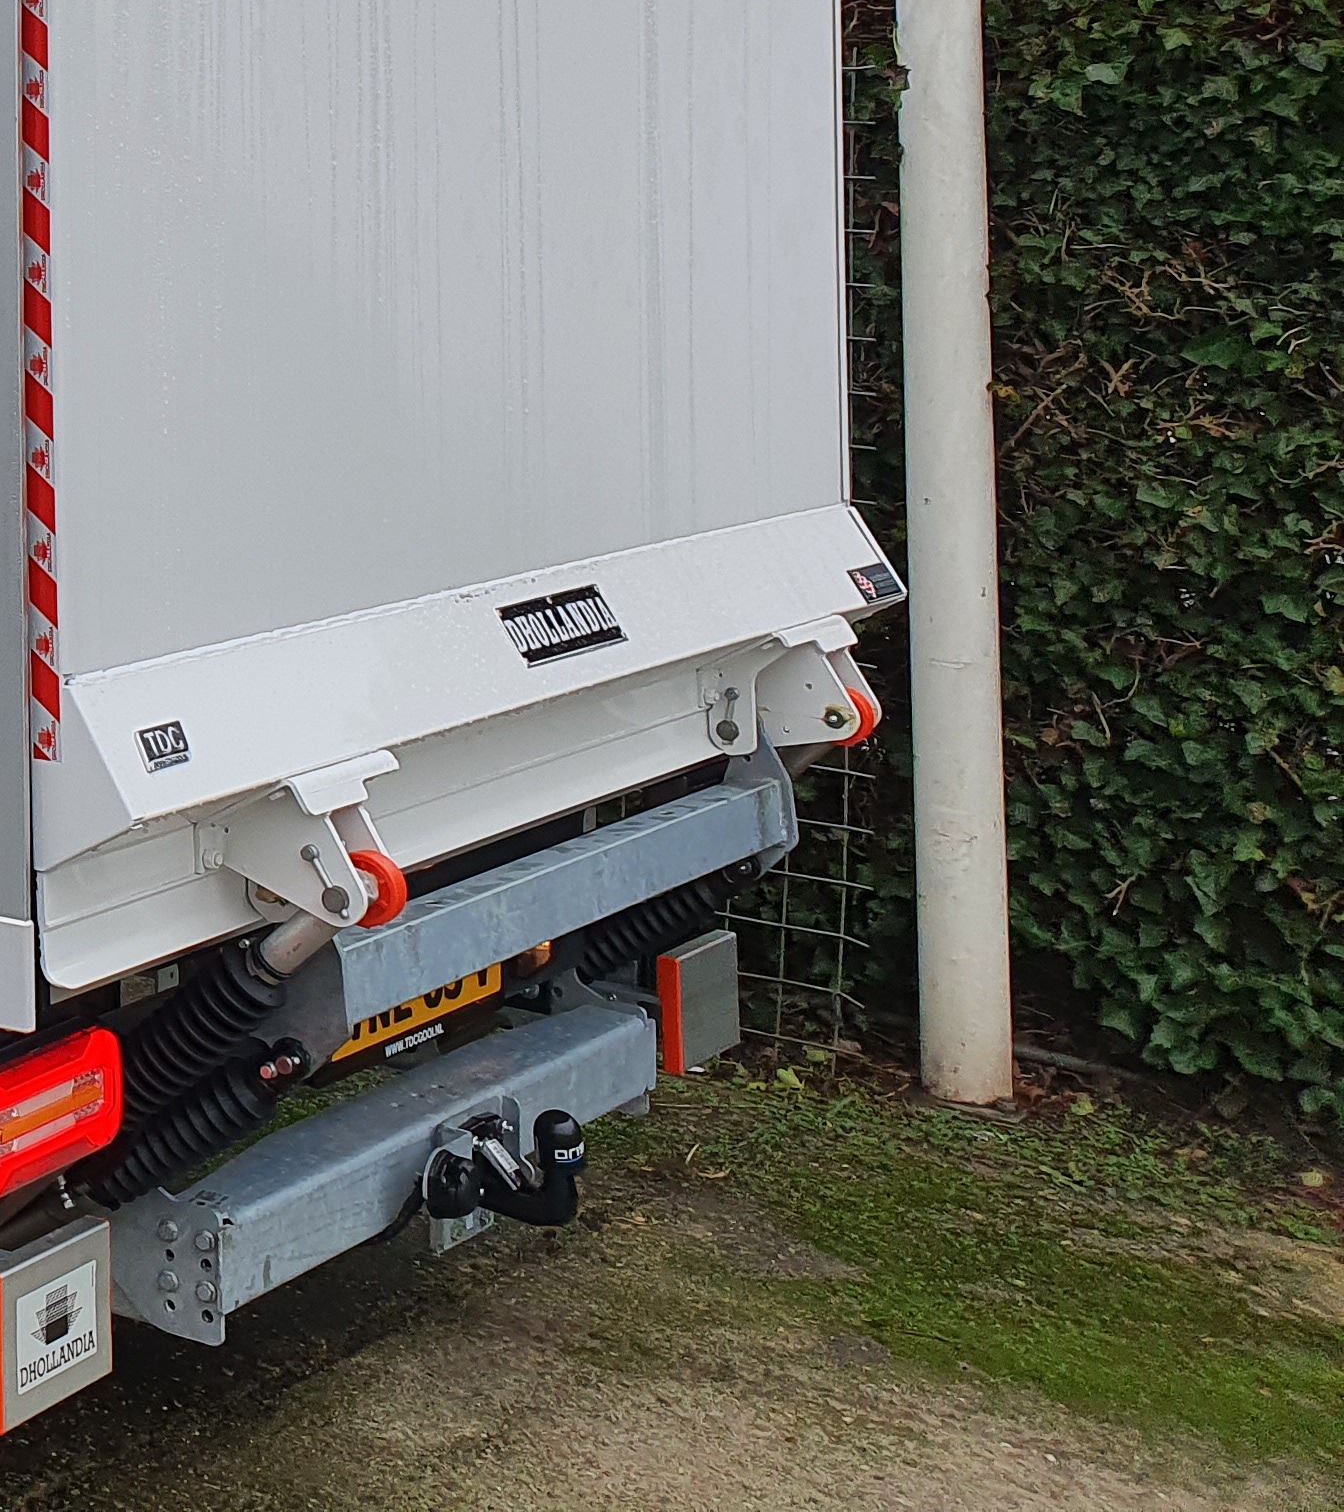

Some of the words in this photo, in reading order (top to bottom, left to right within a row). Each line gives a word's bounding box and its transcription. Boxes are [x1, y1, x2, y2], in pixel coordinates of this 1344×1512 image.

[503, 596, 618, 653] DHOLLANDIA
[143, 726, 184, 756] TDC
[20, 1330, 96, 1388] DHOLLANDIA
